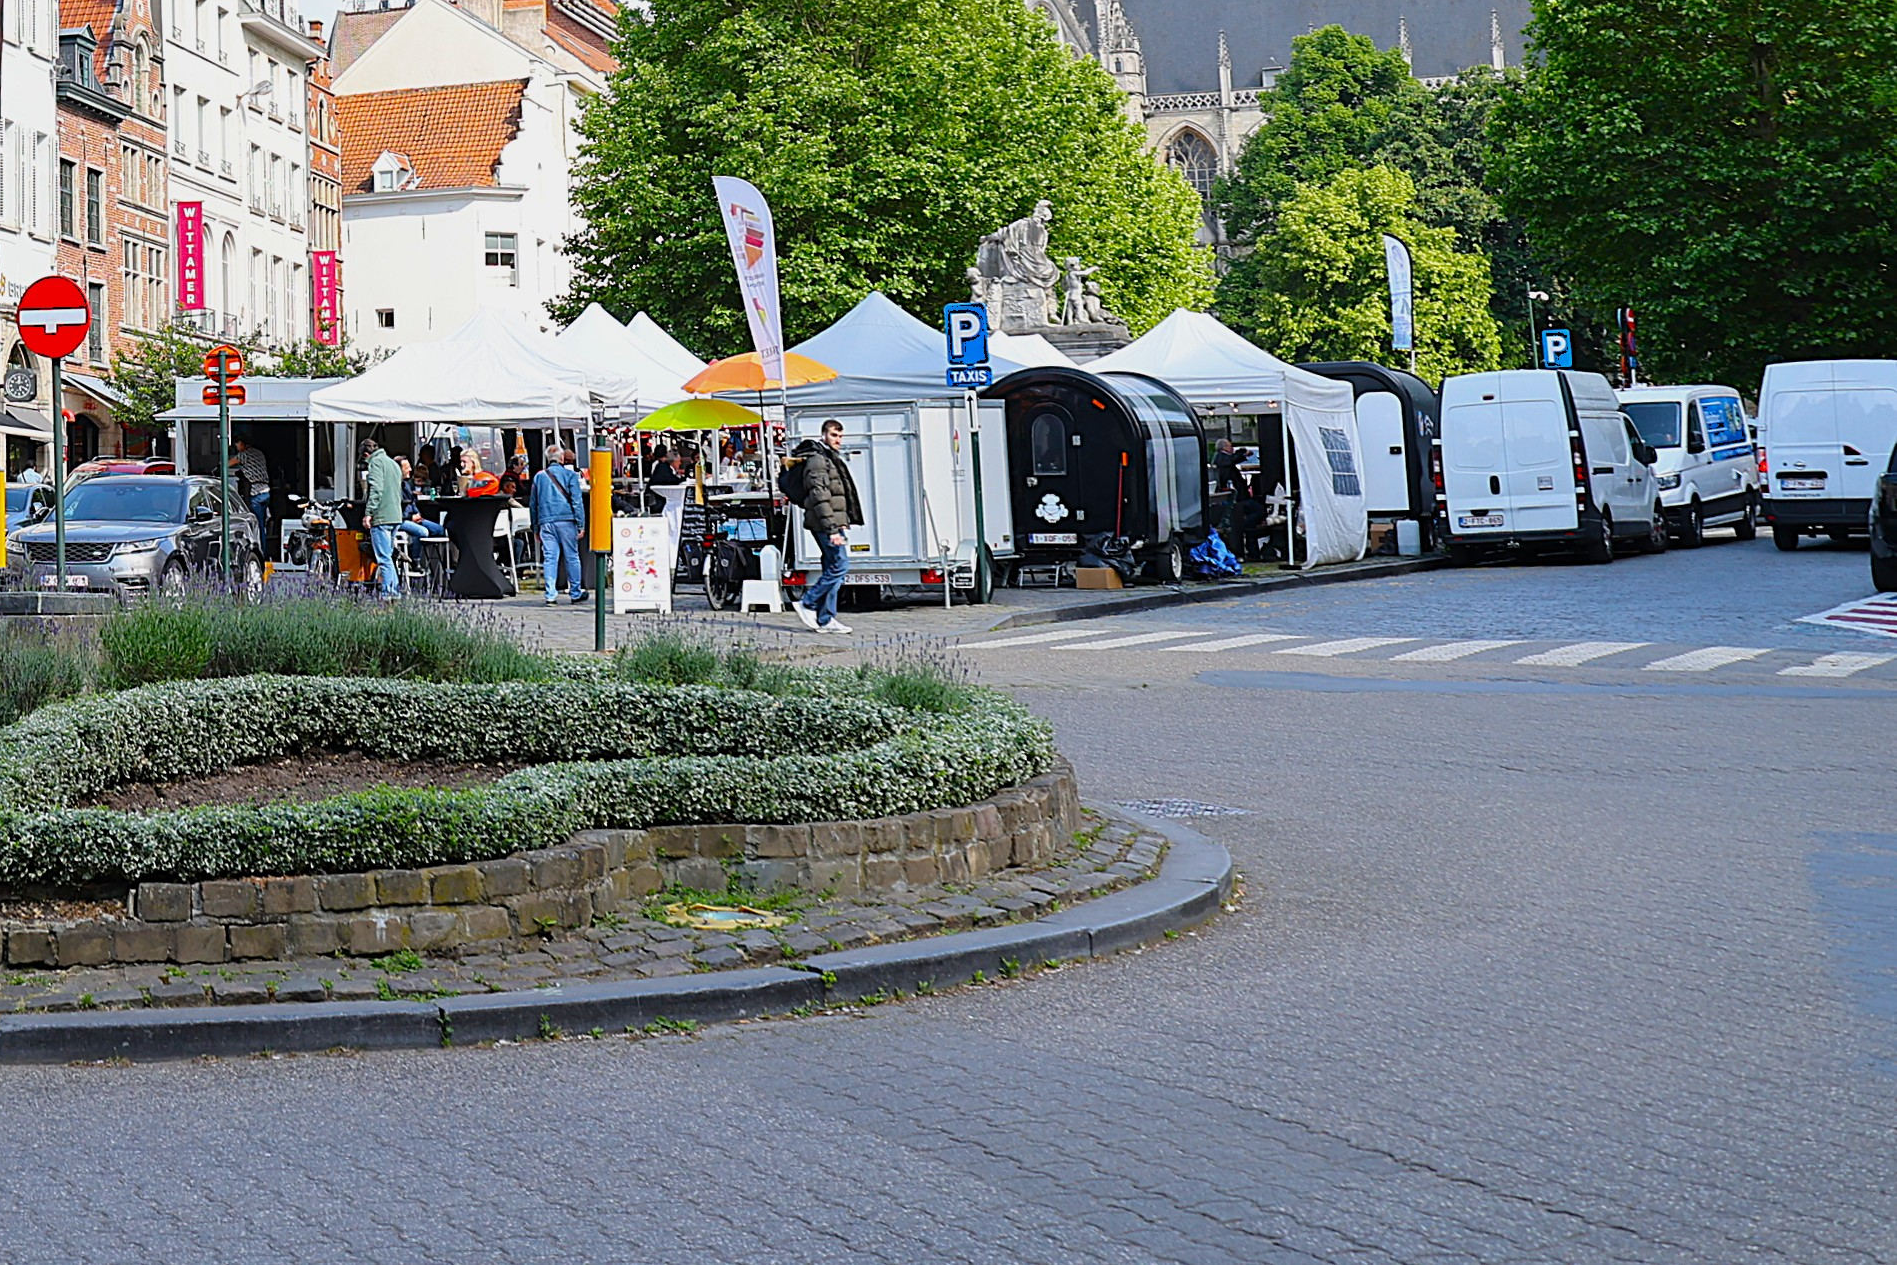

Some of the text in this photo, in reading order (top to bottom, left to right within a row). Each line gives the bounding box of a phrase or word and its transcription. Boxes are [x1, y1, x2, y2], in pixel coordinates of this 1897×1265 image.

[183, 207, 196, 304] WITTAMER
[951, 312, 980, 356] P
[1546, 335, 1566, 363] P
[951, 370, 987, 382] TAXIS
